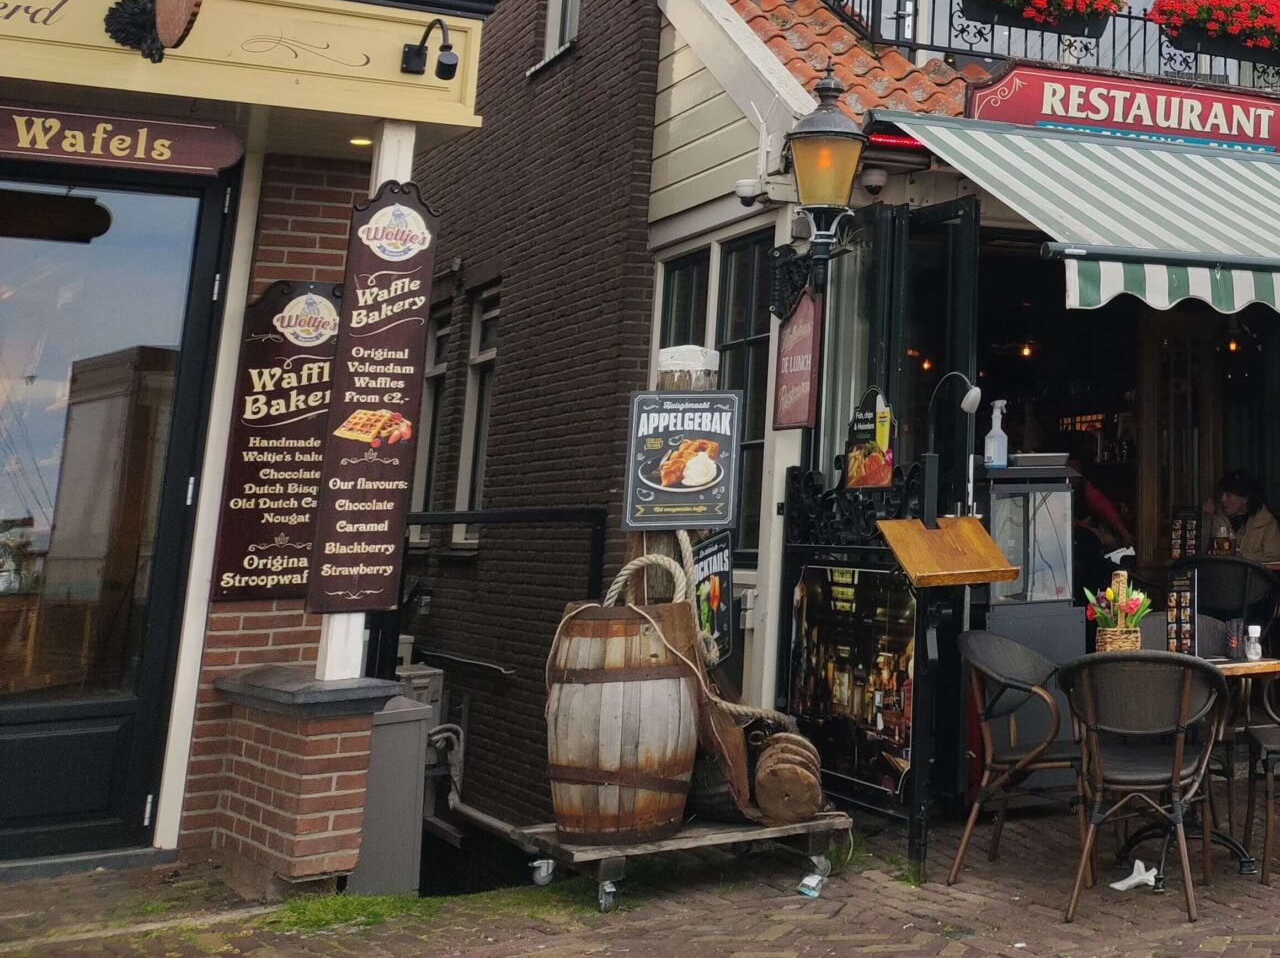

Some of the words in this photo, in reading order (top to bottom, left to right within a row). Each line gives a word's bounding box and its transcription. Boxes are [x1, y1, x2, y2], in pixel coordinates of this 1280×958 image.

[1041, 81, 1274, 139] RESTAURANT
[12, 115, 172, 160] Wafels
[356, 278, 421, 306] Waffle
[350, 295, 426, 328] Bakery
[351, 347, 408, 360] Original
[347, 361, 414, 374] Volendam
[781, 357, 790, 373] DE
[790, 354, 812, 372] LUNCH
[354, 377, 405, 389] Waffles
[344, 391, 379, 403] From
[383, 392, 410, 404] €2,-
[638, 412, 732, 437] APPELGEBAK
[248, 436, 322, 448] Handmade
[242, 451, 292, 463] Woltje's
[259, 469, 320, 479] Chocolate
[244, 484, 283, 494] Dutch
[329, 477, 353, 491] Our
[357, 477, 408, 490] flavours:
[229, 498, 255, 509] Old
[258, 497, 298, 508] Dutch
[335, 499, 394, 511] Chocolate
[261, 513, 310, 525] Nougat
[336, 520, 388, 533] Caramel
[324, 542, 395, 555] Blackberry
[321, 563, 393, 576] Strawberry
